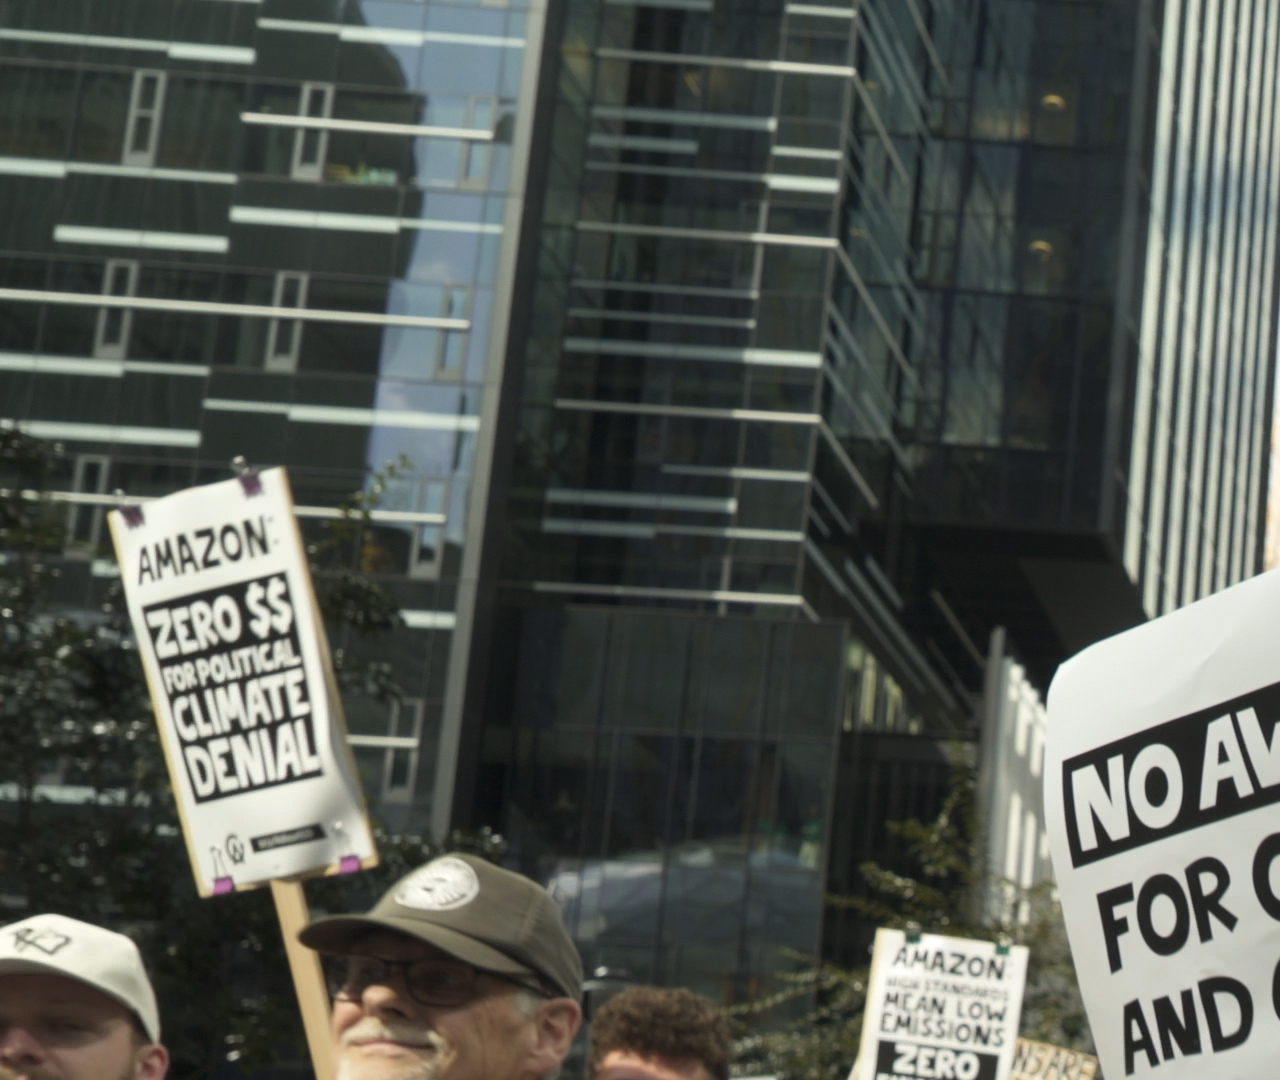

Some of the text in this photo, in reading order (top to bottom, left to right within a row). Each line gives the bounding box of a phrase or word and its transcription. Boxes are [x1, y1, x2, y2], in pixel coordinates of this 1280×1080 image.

[147, 576, 294, 659] ZERO $$
[163, 638, 302, 695] FOR POLITICAL
[172, 669, 310, 742] CLIMATE
[184, 718, 321, 798] DENIAL
[1071, 743, 1184, 852] NO
[1096, 856, 1239, 975] FOR
[880, 1012, 1005, 1047] EMISSIONS
[883, 991, 1007, 1023] MEAN LOW
[1123, 975, 1254, 1077] AND
